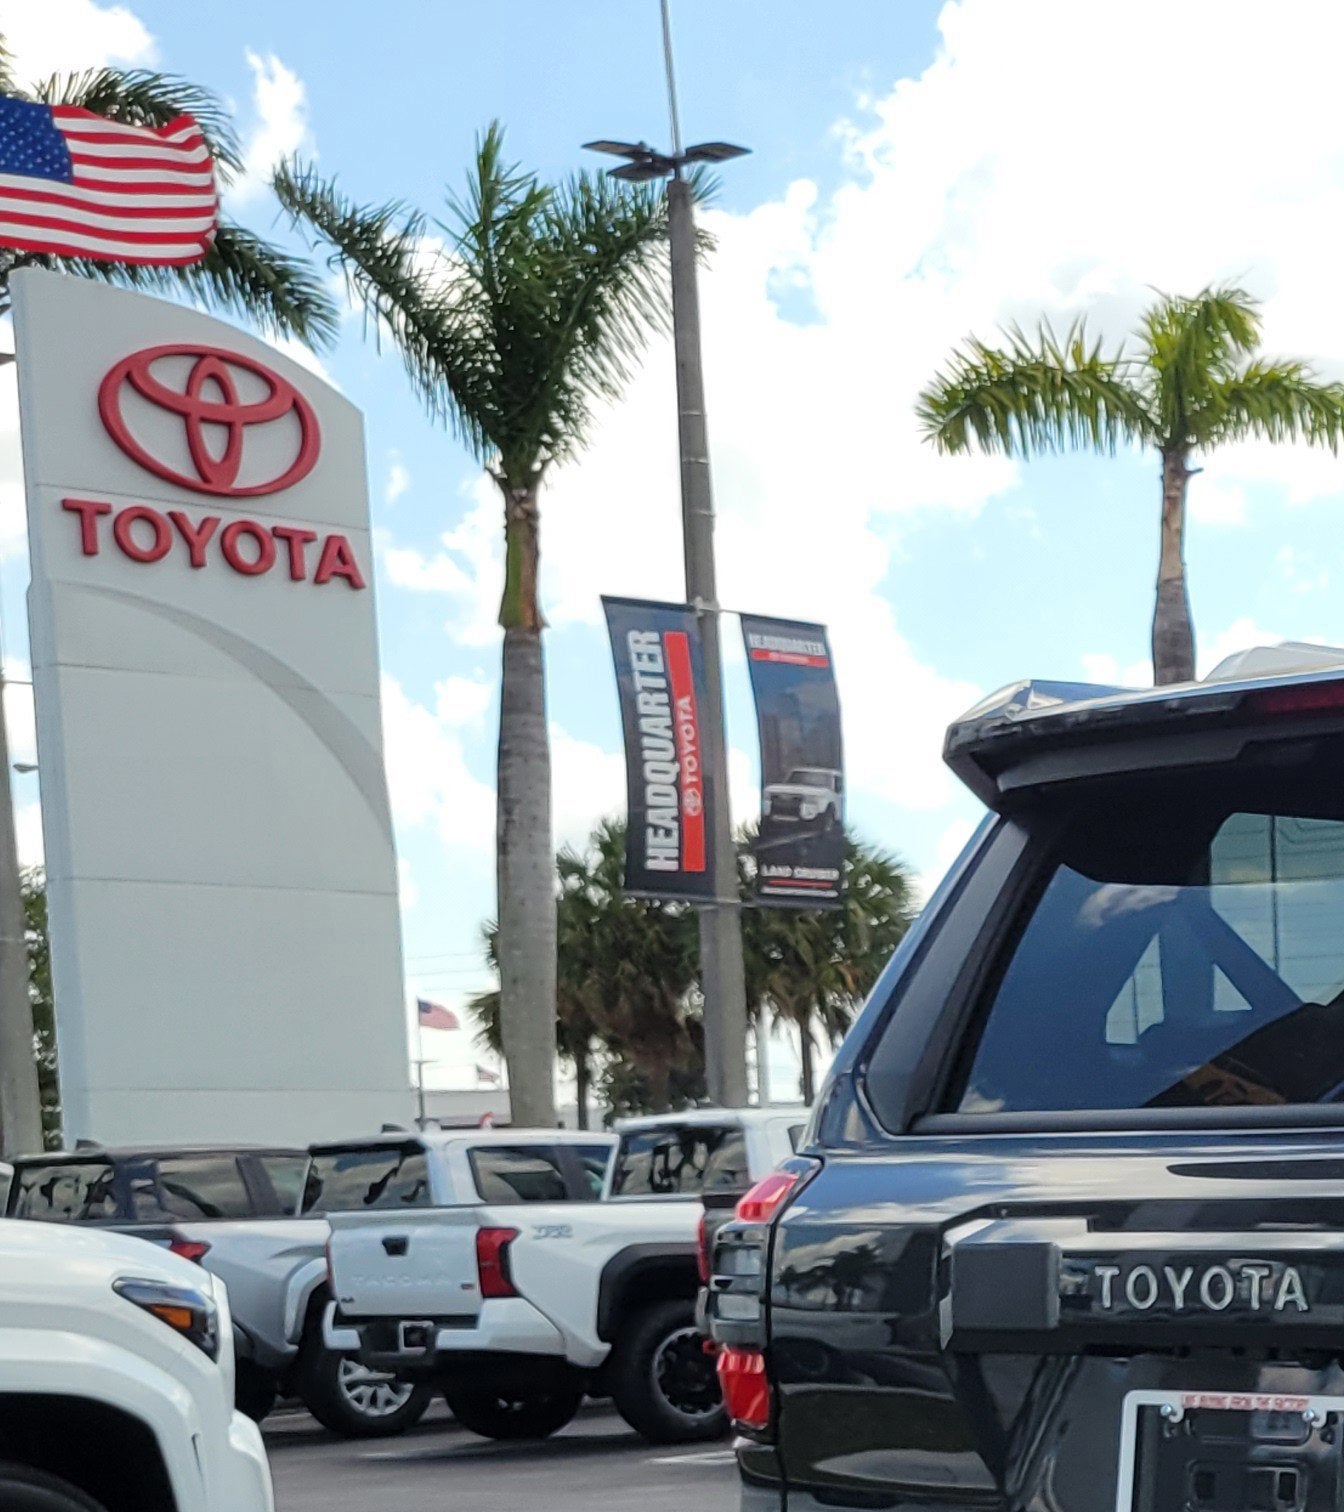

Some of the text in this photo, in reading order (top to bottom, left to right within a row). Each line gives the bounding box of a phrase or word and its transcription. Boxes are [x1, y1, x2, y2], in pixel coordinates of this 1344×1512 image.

[61, 498, 366, 589] TOYOTA
[627, 630, 679, 871] HEADQUARTER
[676, 695, 699, 785] TOYOTA
[1094, 1265, 1309, 1312] TOYOTA
